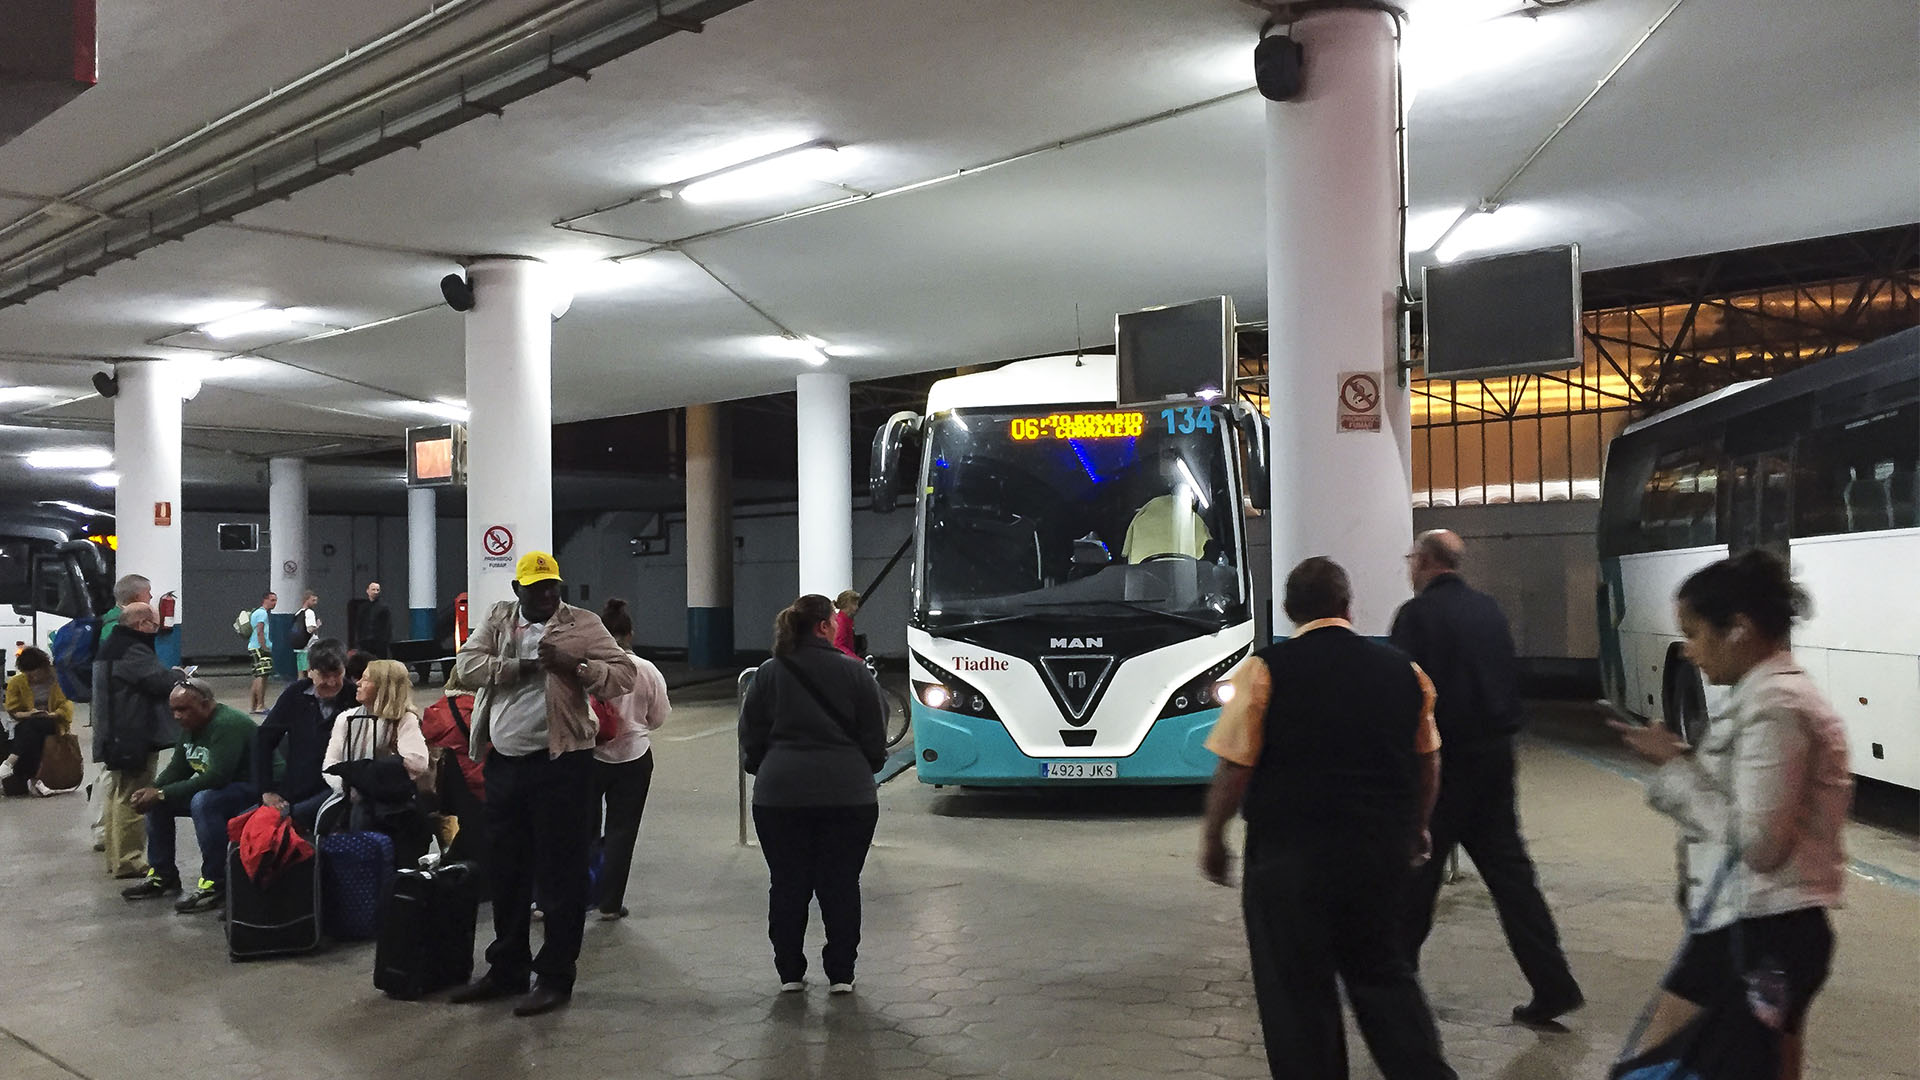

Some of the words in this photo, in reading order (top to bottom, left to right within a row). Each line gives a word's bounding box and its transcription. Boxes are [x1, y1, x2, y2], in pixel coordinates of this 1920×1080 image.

[1161, 405, 1215, 434] 134
[1050, 637, 1103, 648] MAN
[951, 656, 1009, 671] Tiadhe
[1051, 764, 1084, 777] 4923
[1089, 764, 1113, 777] JKS
